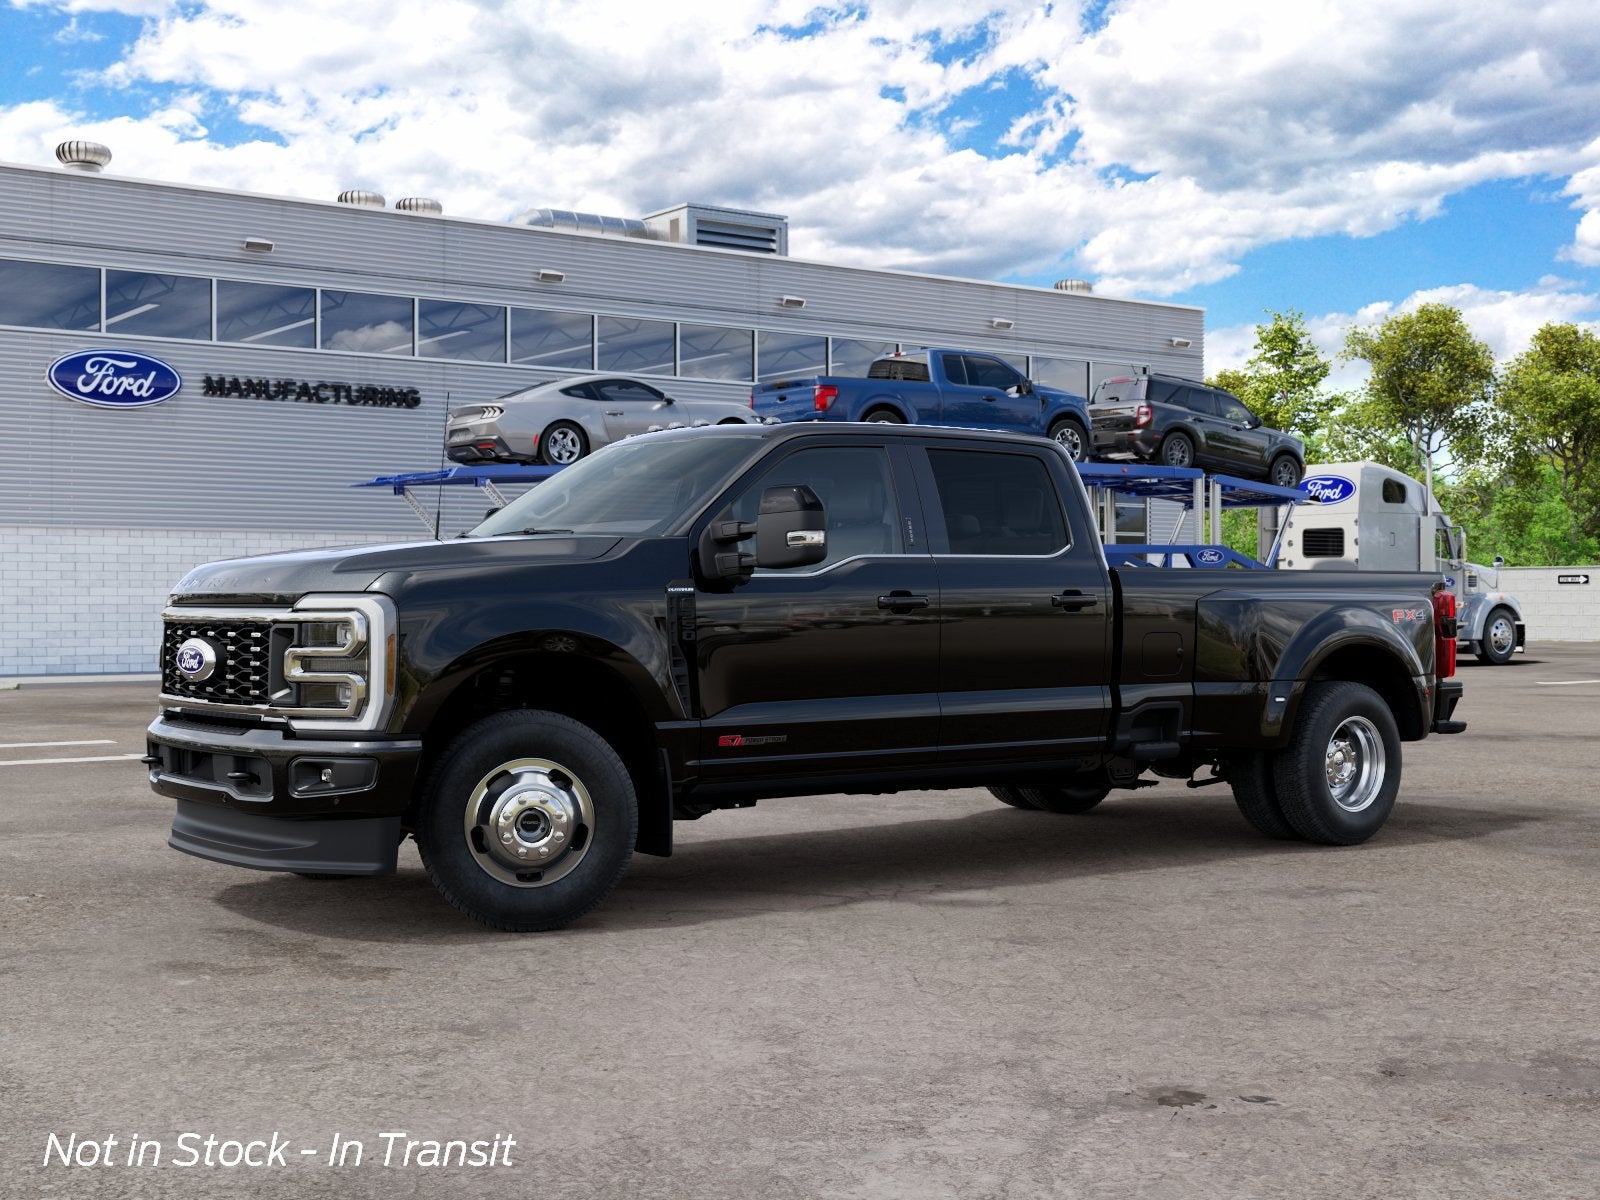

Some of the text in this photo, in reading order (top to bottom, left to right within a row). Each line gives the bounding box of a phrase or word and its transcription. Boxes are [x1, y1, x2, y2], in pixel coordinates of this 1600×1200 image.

[77, 357, 157, 397] Ford
[203, 374, 421, 409] MANUFACTURING
[1305, 480, 1343, 500] Ford
[1201, 551, 1219, 561] Ford
[181, 650, 199, 669] Ford
